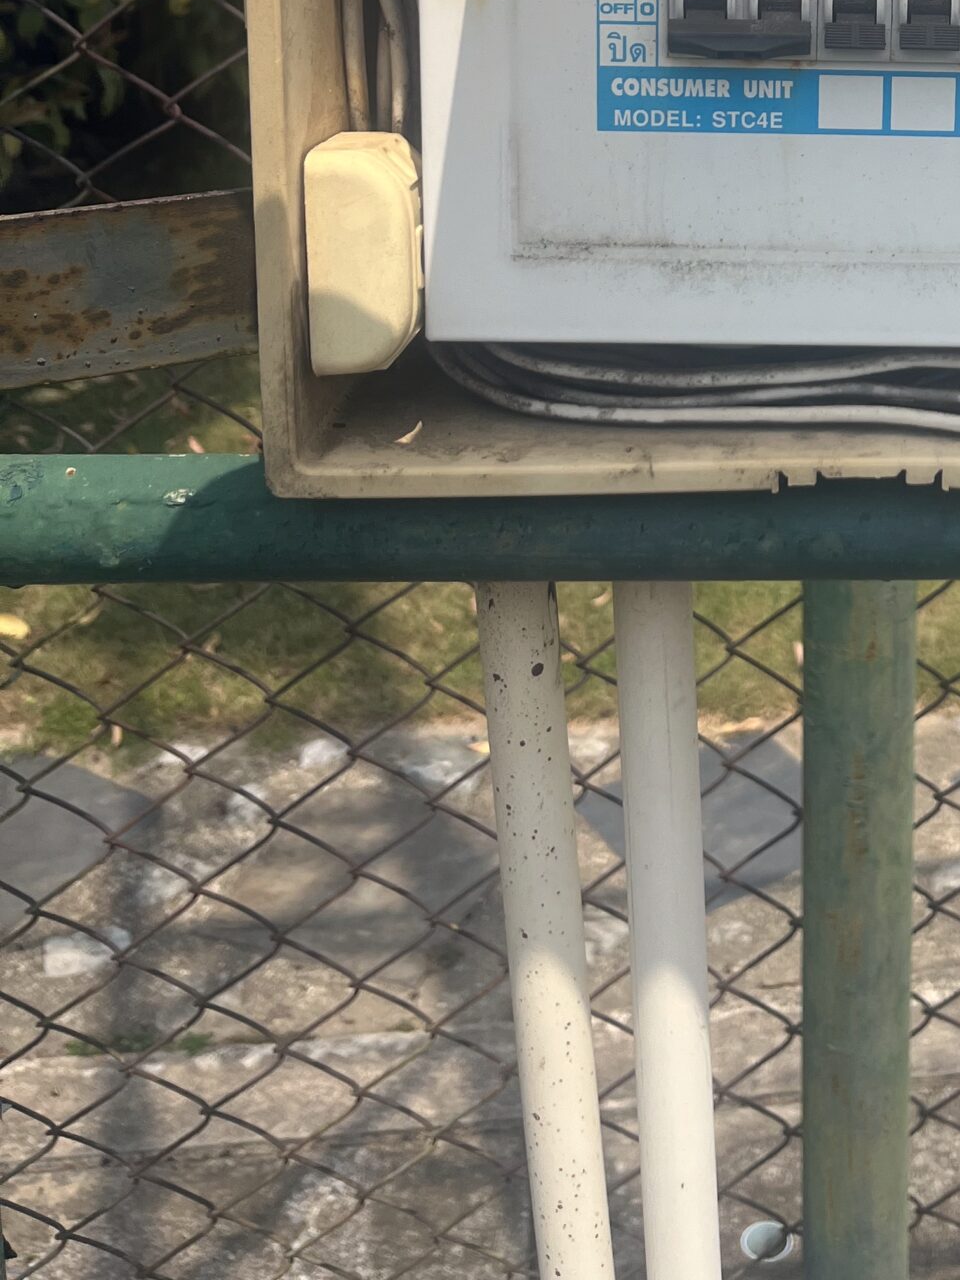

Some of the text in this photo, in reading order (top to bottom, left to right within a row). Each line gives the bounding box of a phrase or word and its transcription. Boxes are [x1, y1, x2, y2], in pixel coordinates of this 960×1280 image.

[600, 3, 634, 15] OFF
[607, 31, 647, 63] ปิด
[611, 76, 794, 99] CONSUMER UNIT
[614, 109, 784, 129] MODEL: STC4E
